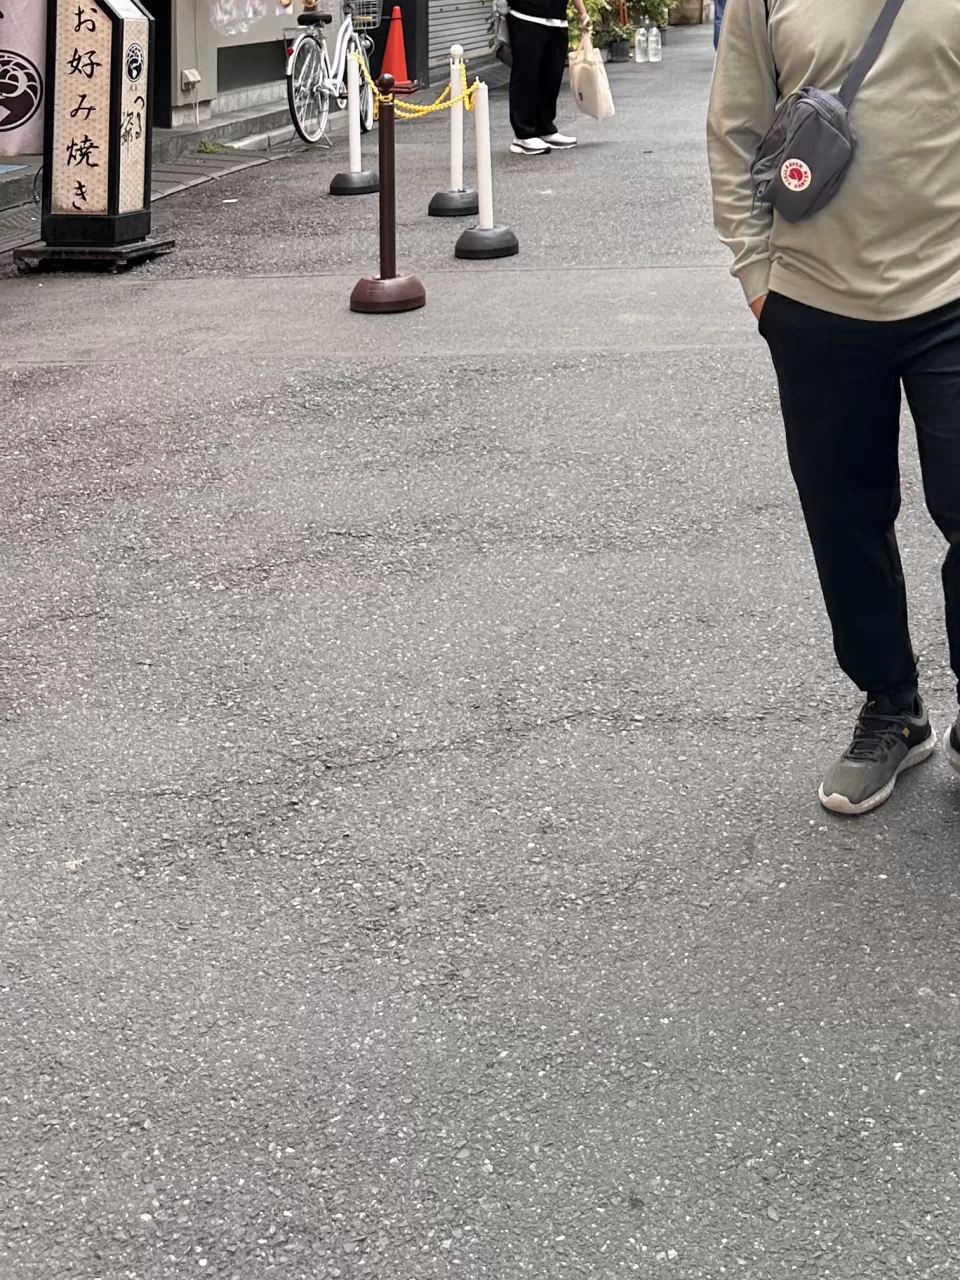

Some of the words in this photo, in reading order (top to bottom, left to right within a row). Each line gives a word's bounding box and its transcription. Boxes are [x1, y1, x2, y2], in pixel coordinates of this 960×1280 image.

[66, 6, 102, 210] お好み焼き
